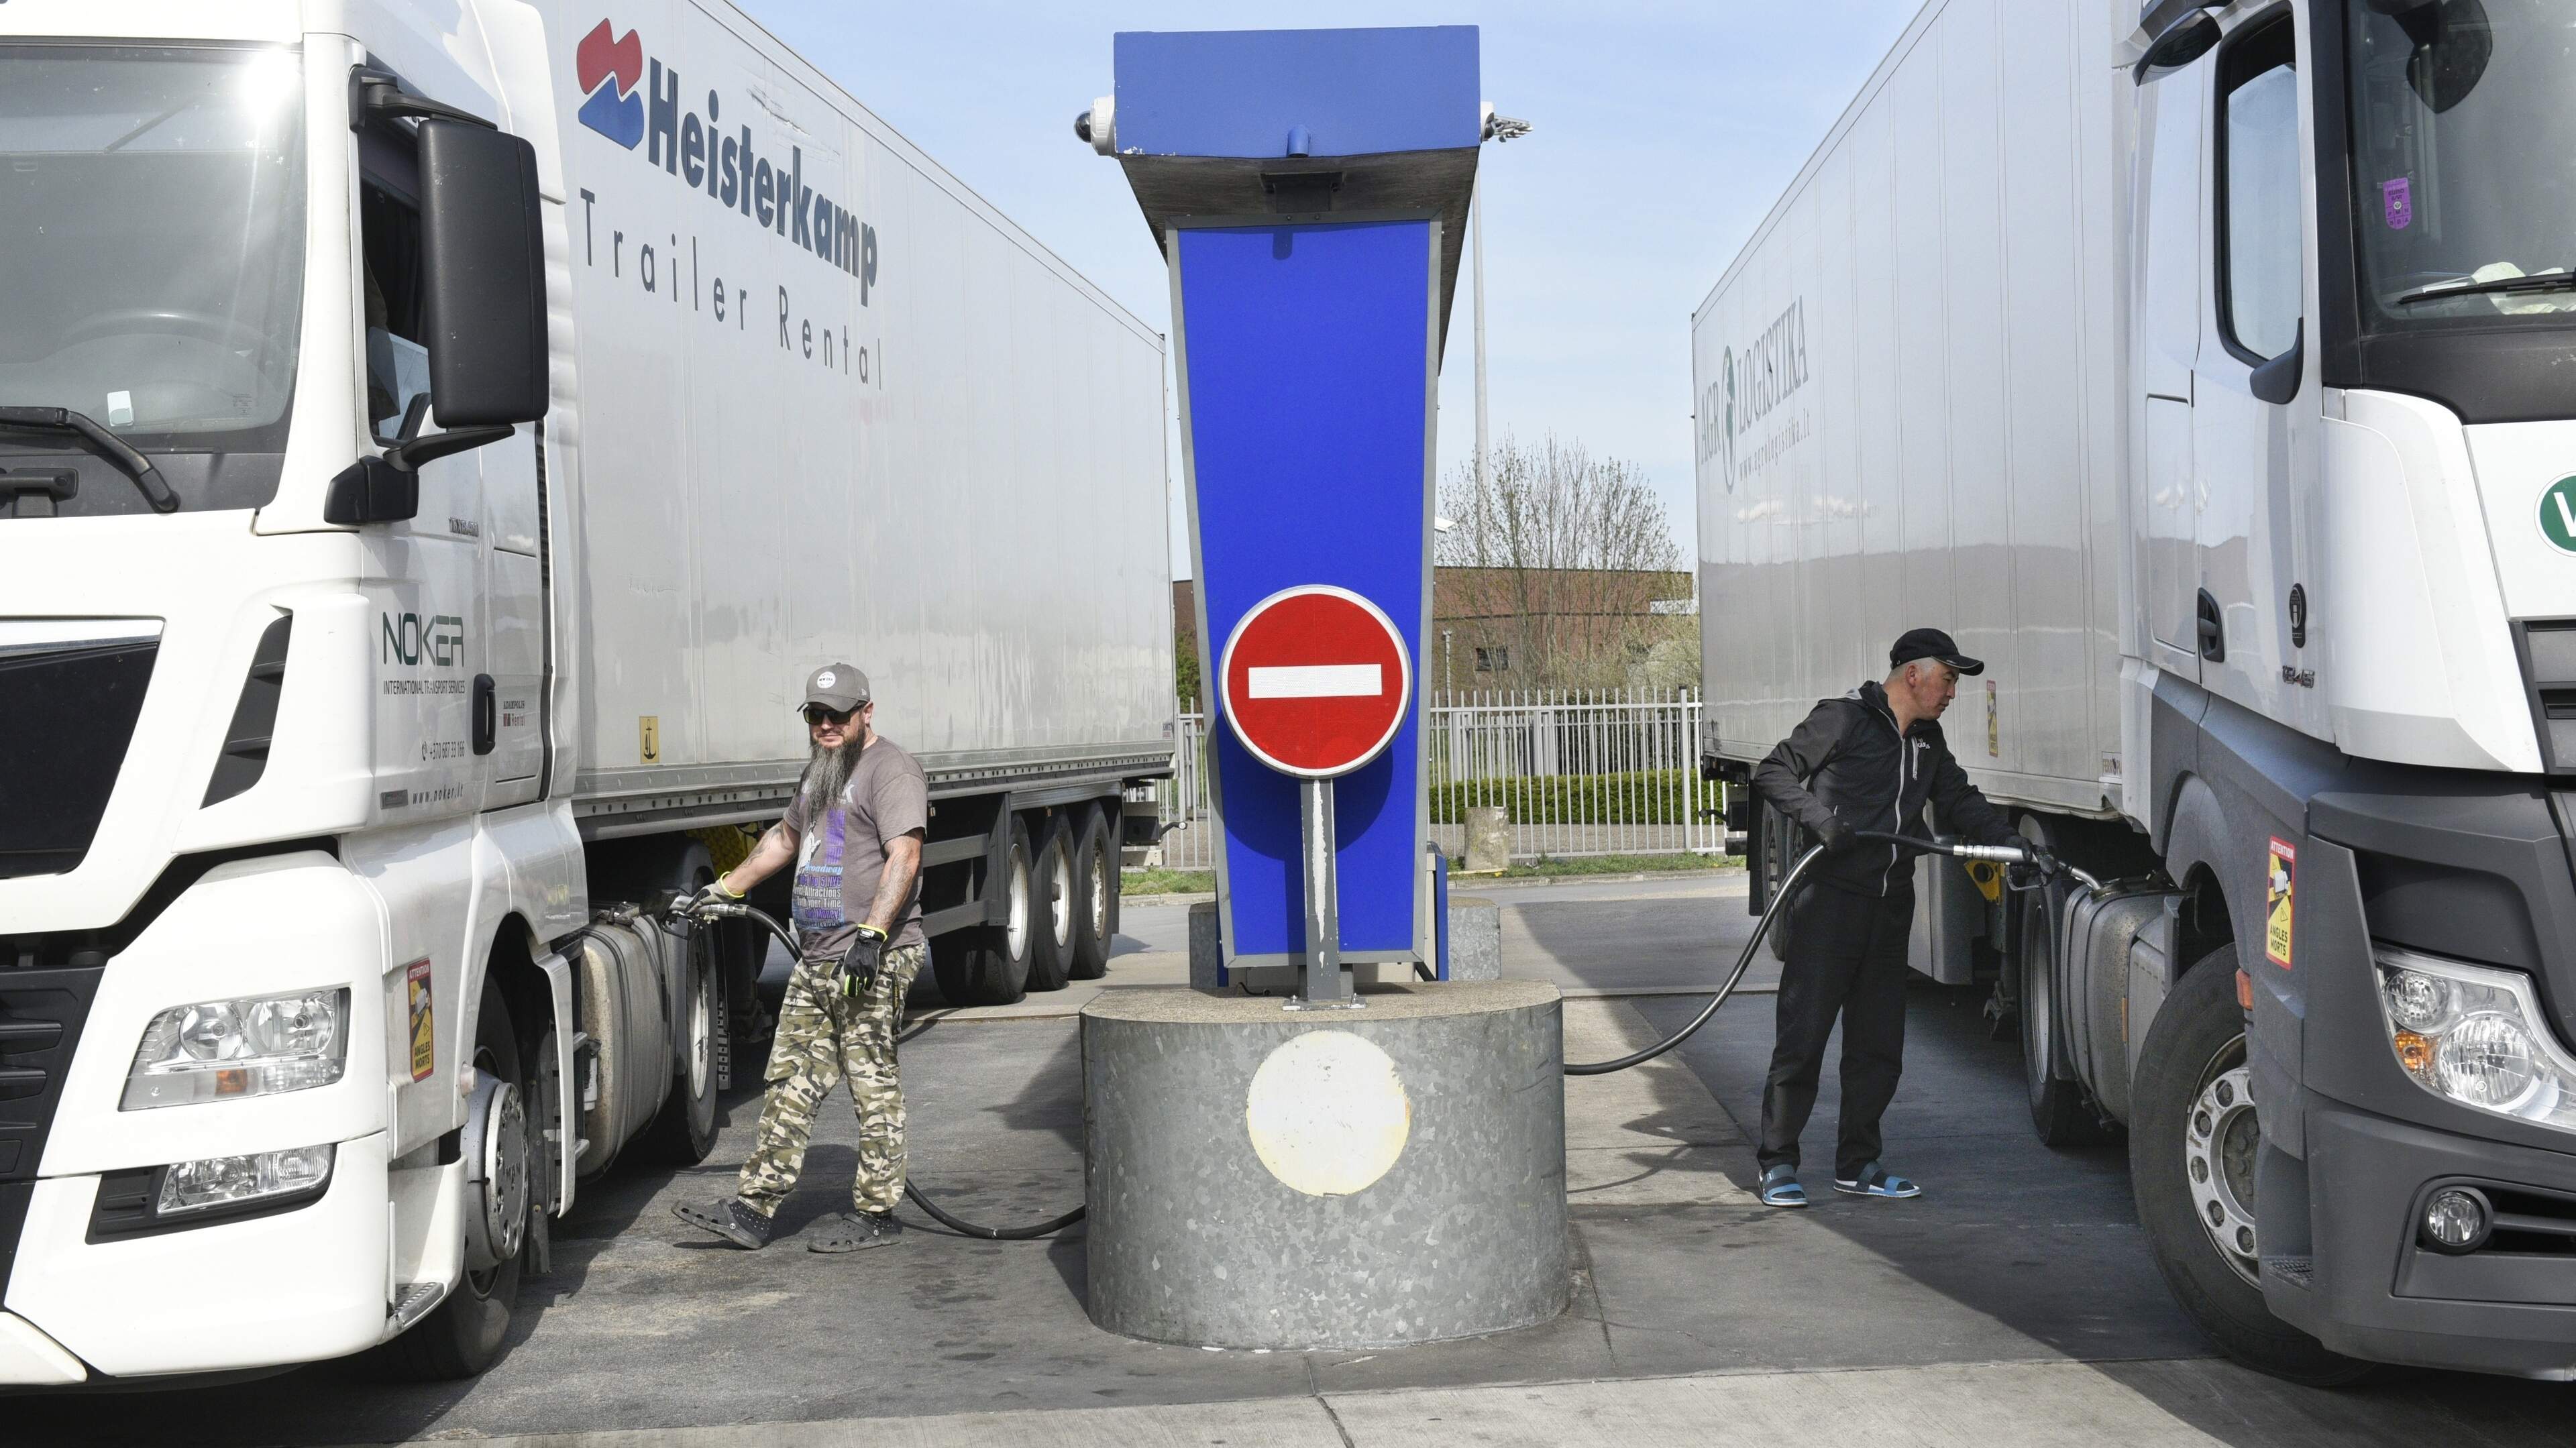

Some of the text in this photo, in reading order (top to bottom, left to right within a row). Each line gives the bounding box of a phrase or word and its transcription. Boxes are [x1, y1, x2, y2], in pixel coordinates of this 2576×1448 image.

[648, 56, 877, 308] Heisterkamp
[580, 187, 881, 390] Trailer Rental
[382, 611, 464, 667] NOKER
[383, 680, 466, 695] INTERNATIONAL TRANSPORT SERVICES
[430, 742, 442, 760] +370
[451, 741, 456, 758] 33
[413, 782, 463, 805] www.noker.lt
[2271, 840, 2294, 860] ATTENTION
[820, 876, 826, 887] 5
[828, 876, 841, 887] NYC
[805, 886, 841, 898] Attractions
[823, 899, 841, 908] Time
[816, 908, 841, 920] Money!
[2270, 923, 2288, 943] ANGLES
[2270, 938, 2287, 956] MORTS
[409, 964, 430, 979] ATTENTION
[414, 1040, 431, 1058] ANGLES
[415, 1054, 430, 1070] MORTS
